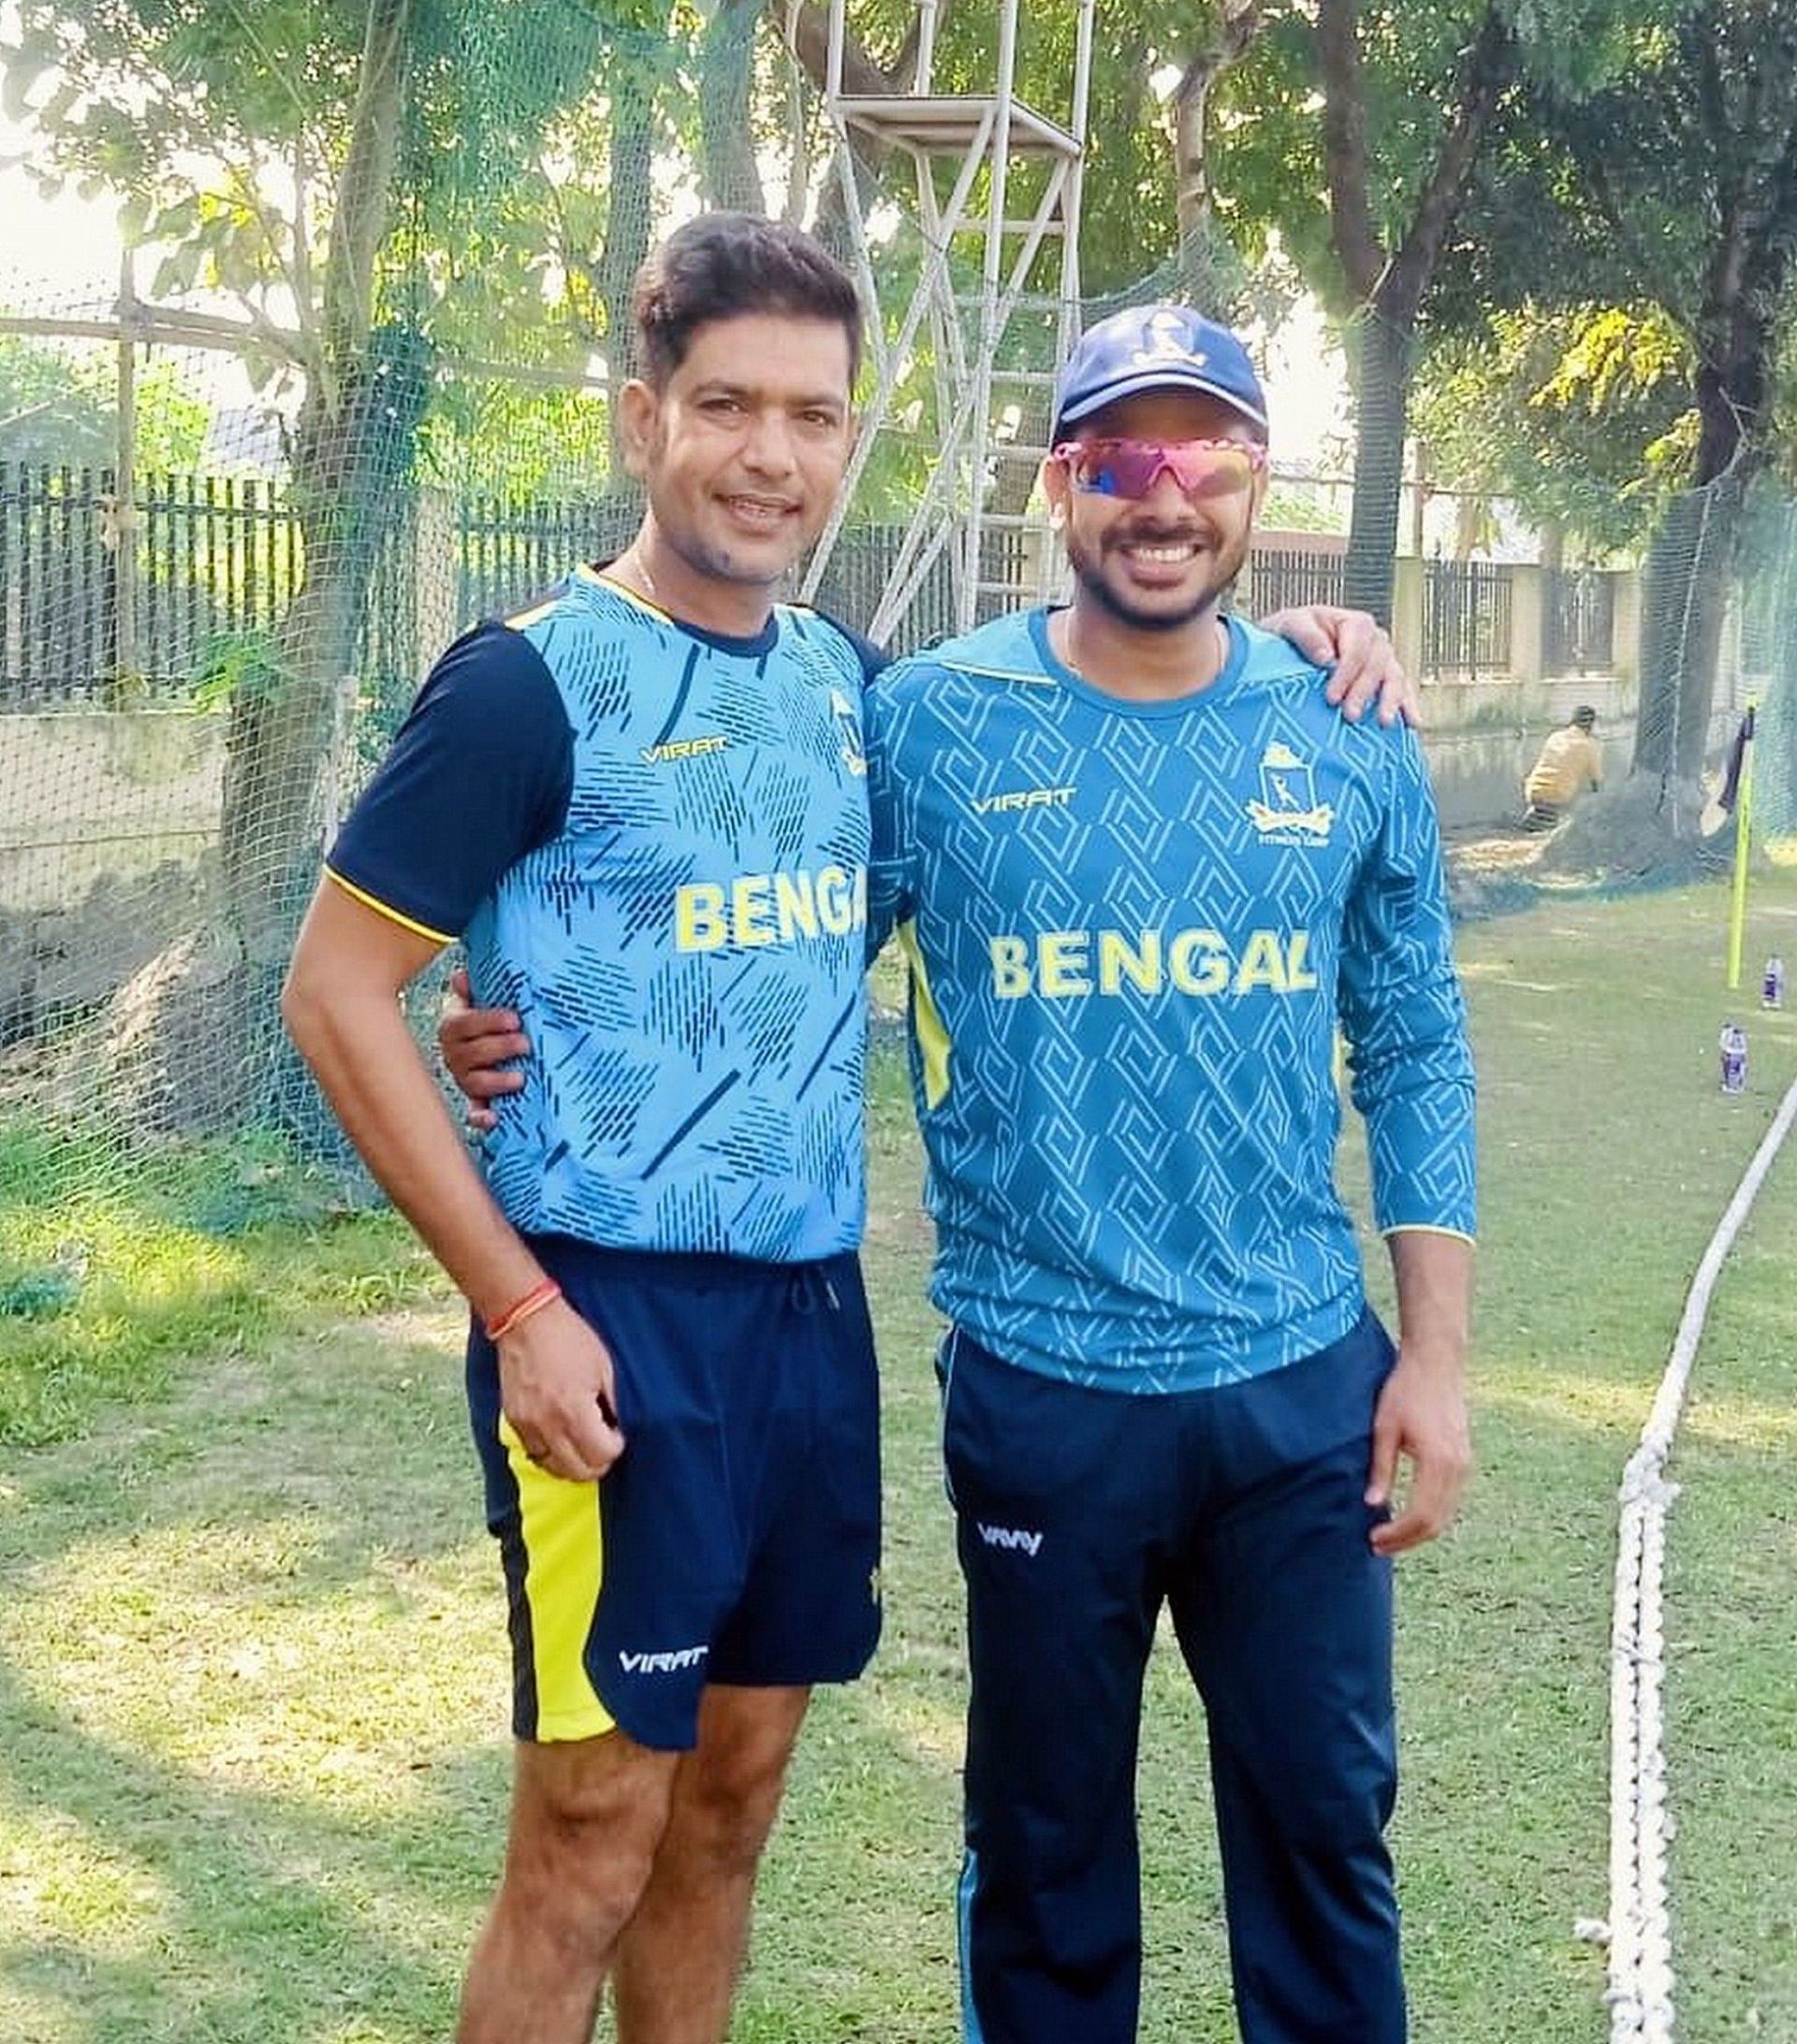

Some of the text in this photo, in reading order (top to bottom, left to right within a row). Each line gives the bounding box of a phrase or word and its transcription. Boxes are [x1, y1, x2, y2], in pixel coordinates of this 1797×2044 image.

[638, 736, 729, 766] VIRAT
[970, 785, 1077, 814] VIRAT
[989, 927, 1319, 999] BENGAL
[619, 1645, 709, 1673] VIRAT
